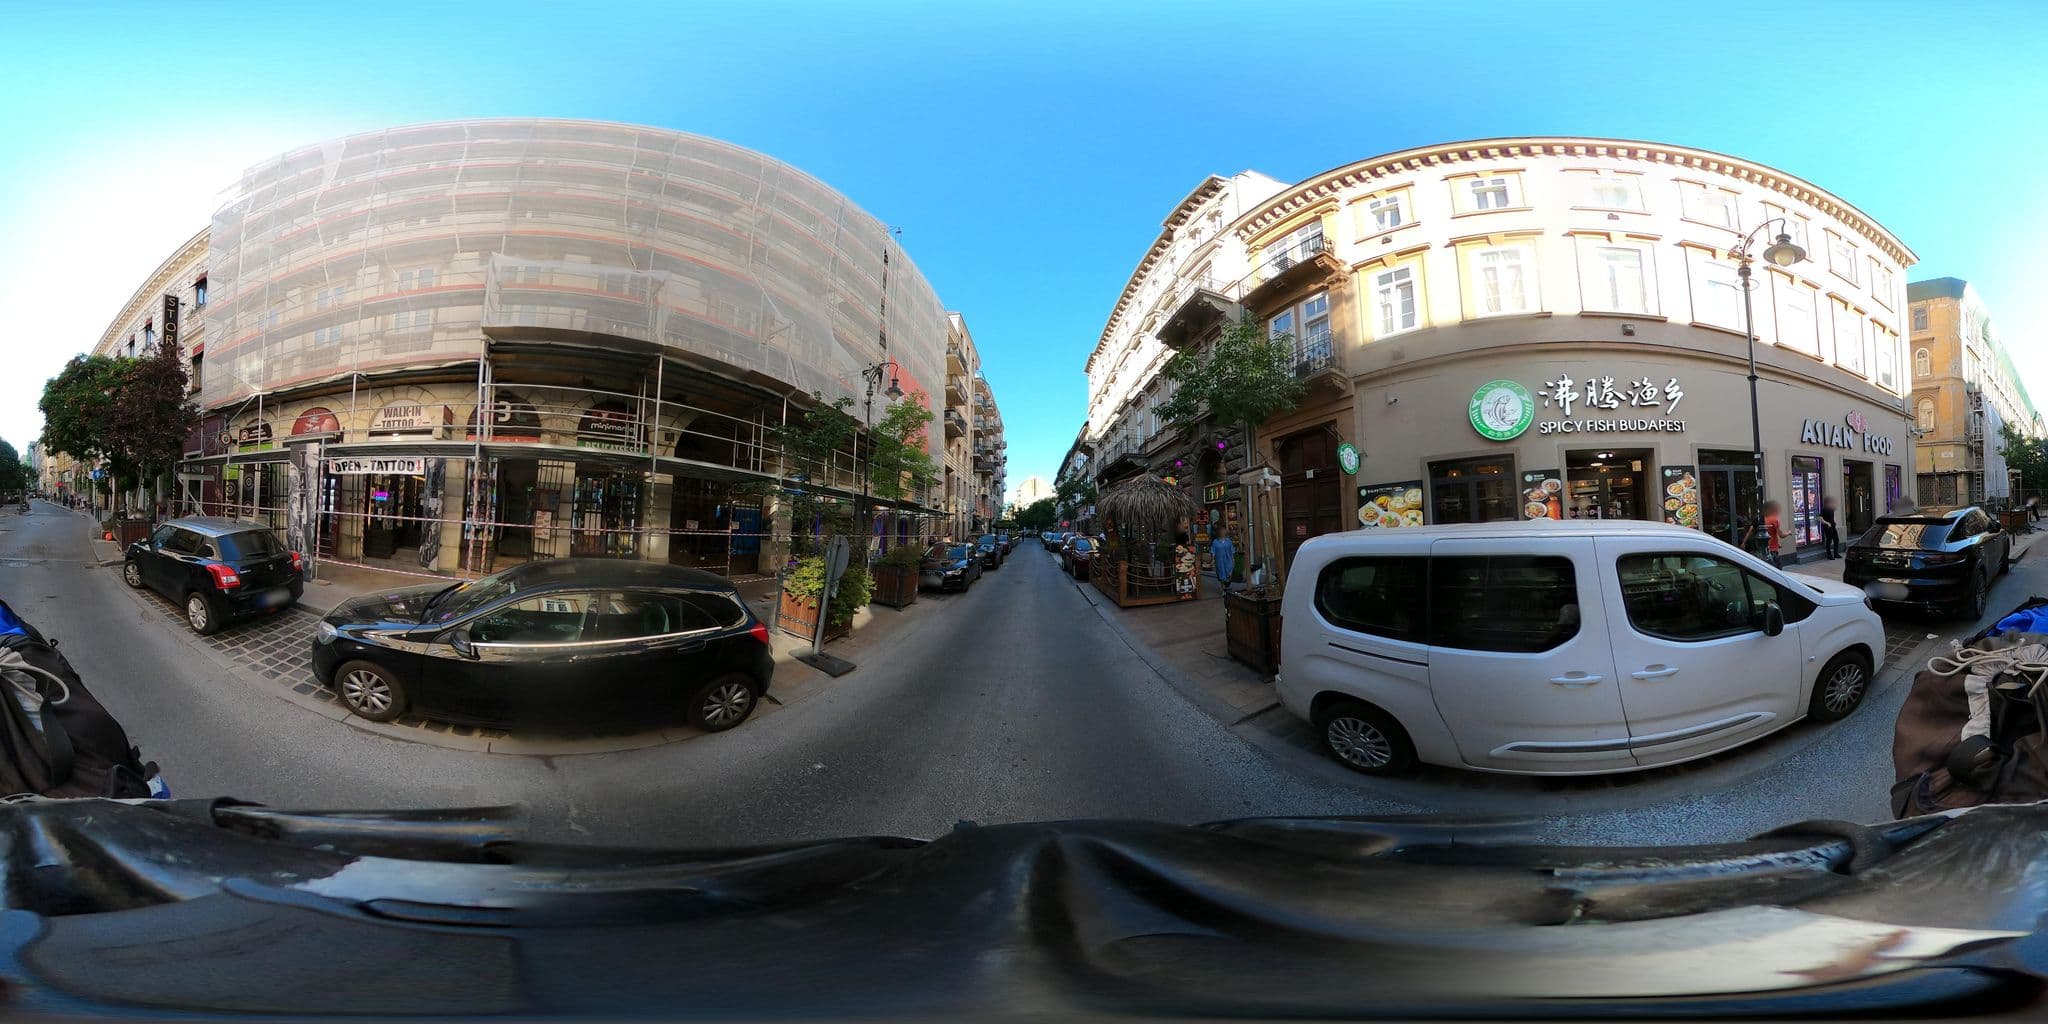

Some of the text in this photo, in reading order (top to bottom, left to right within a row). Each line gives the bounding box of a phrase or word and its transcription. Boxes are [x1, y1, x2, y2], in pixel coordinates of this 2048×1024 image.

[381, 418, 414, 428] TATTOO
[1539, 419, 1686, 434] SPICY FISH BUDAPEST
[1801, 418, 1894, 456] ASIAN FOOD
[335, 460, 362, 473] OPEN
[370, 460, 415, 472] TATTOO
